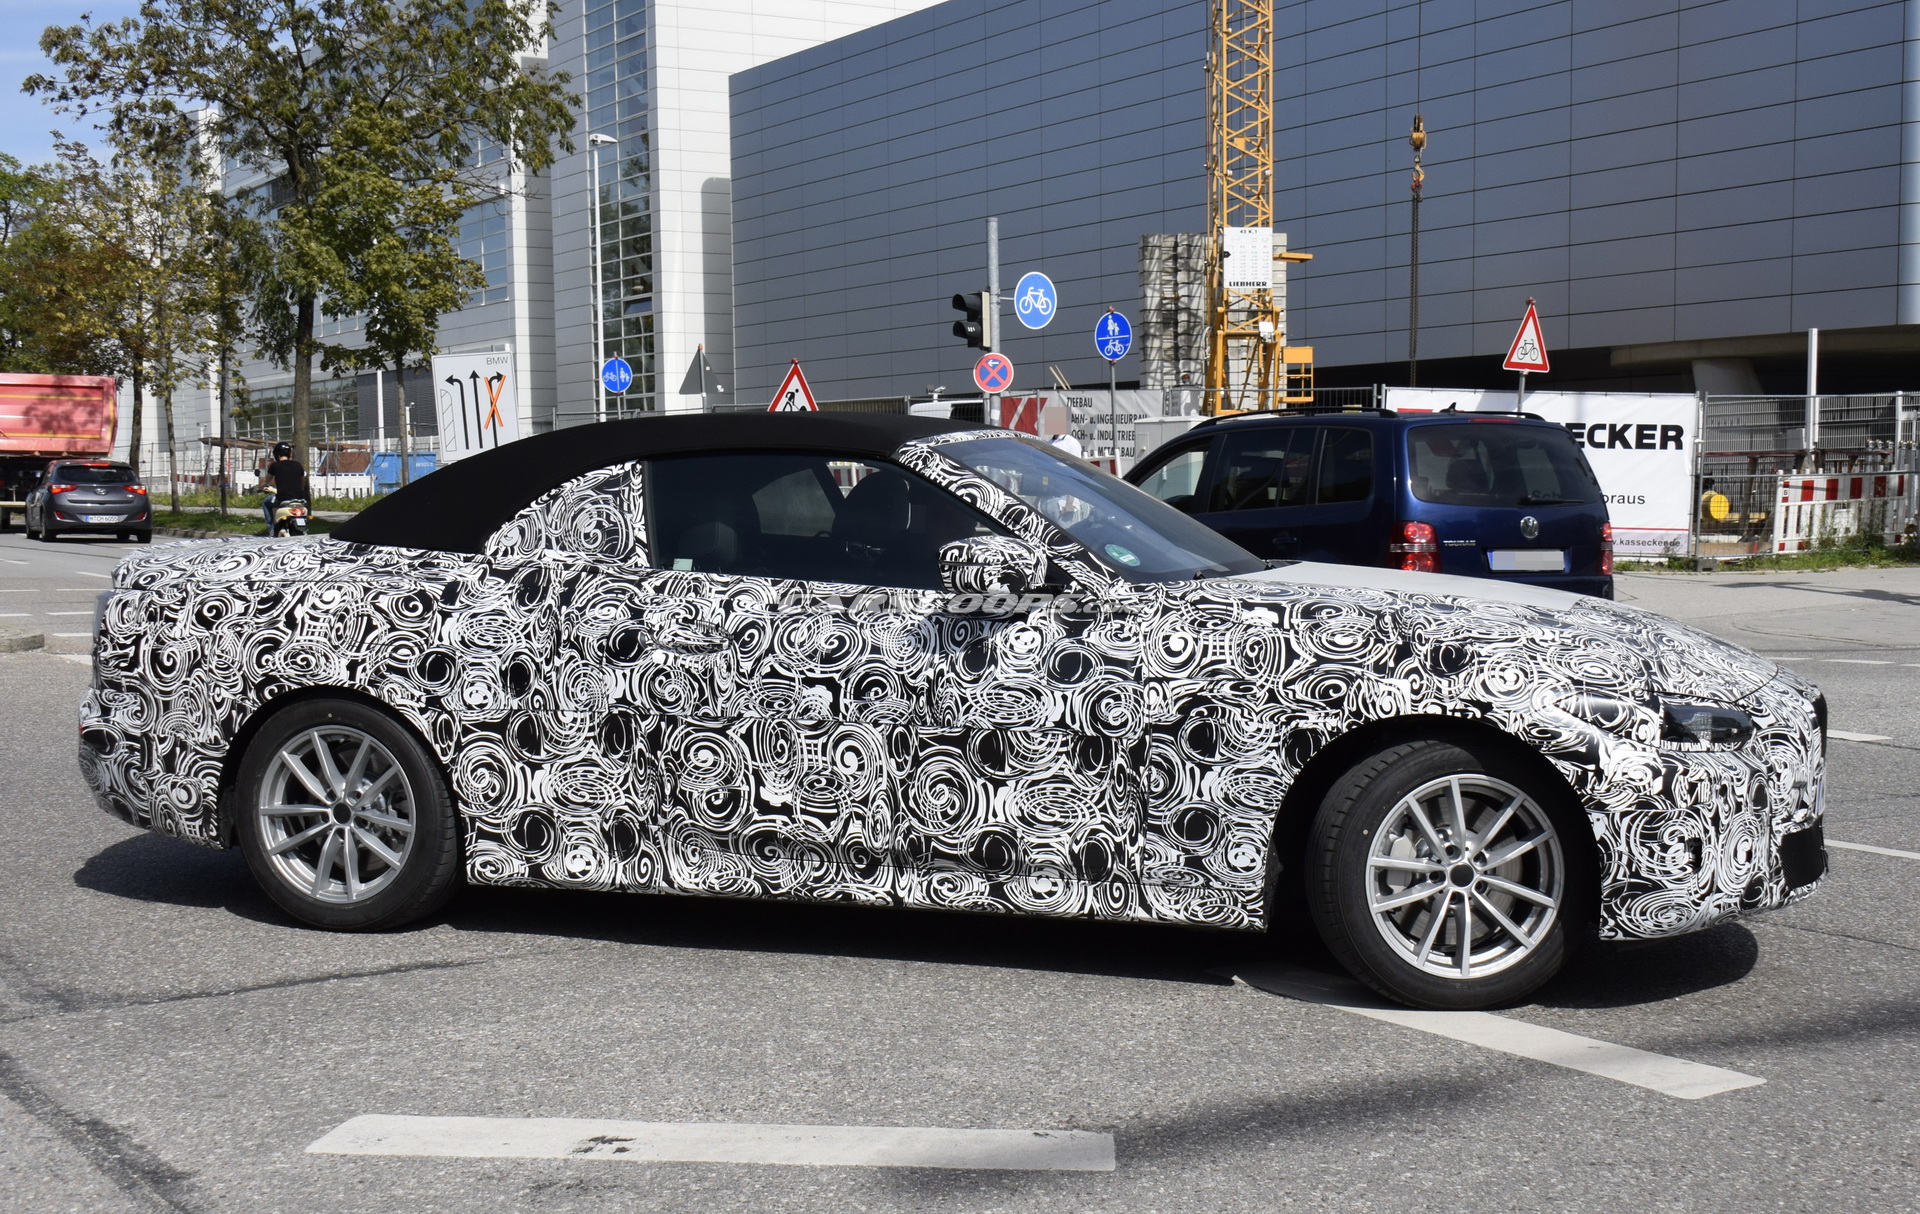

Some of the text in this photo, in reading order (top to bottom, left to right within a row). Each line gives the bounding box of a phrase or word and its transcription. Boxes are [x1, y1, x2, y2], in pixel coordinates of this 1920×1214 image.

[486, 356, 509, 365] BMW
[1066, 397, 1093, 408] TIEFBAU
[1070, 413, 1088, 424] AHN-
[1097, 413, 1147, 425] INGEIEURB
[1071, 429, 1088, 440] OCH-
[1563, 422, 1684, 450] ECKER
[1602, 493, 1646, 505] oraus
[1612, 537, 1681, 547] .kassecker.de
